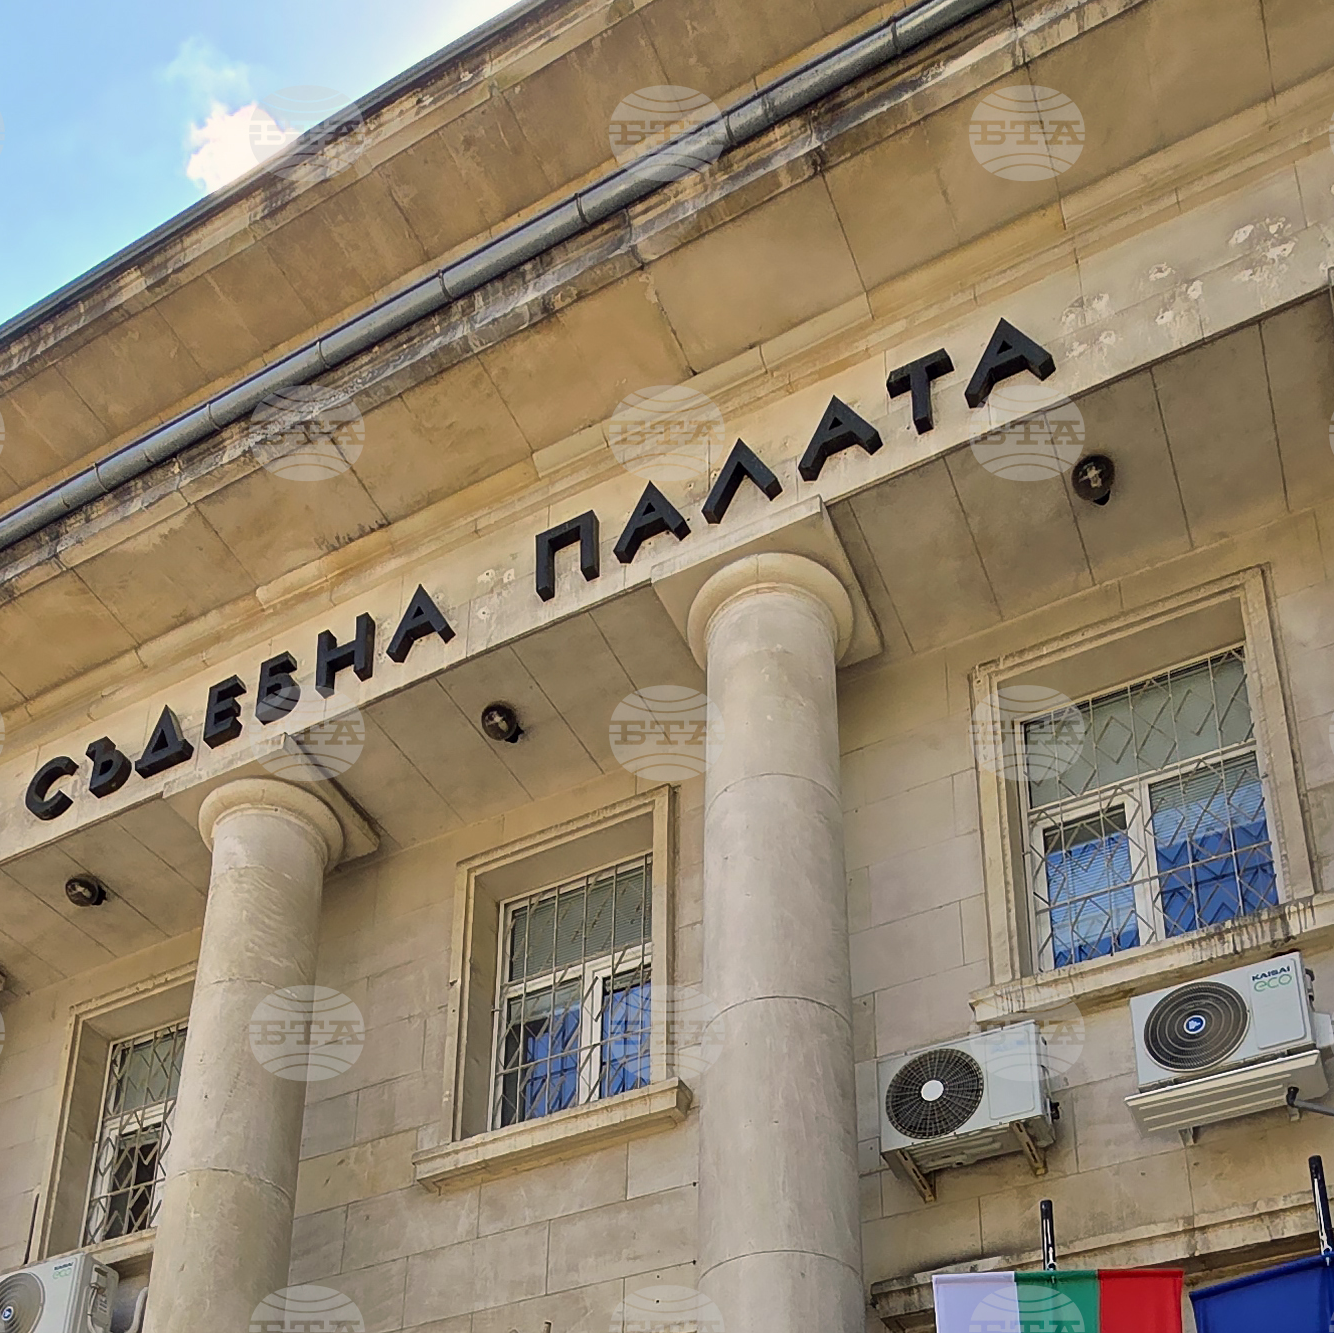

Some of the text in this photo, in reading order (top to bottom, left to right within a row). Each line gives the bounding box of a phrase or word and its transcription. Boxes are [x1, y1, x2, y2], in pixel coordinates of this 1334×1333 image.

[25, 317, 1057, 821] СЪДЕБНА ПАЛАТА
[1254, 974, 1292, 992] eco
